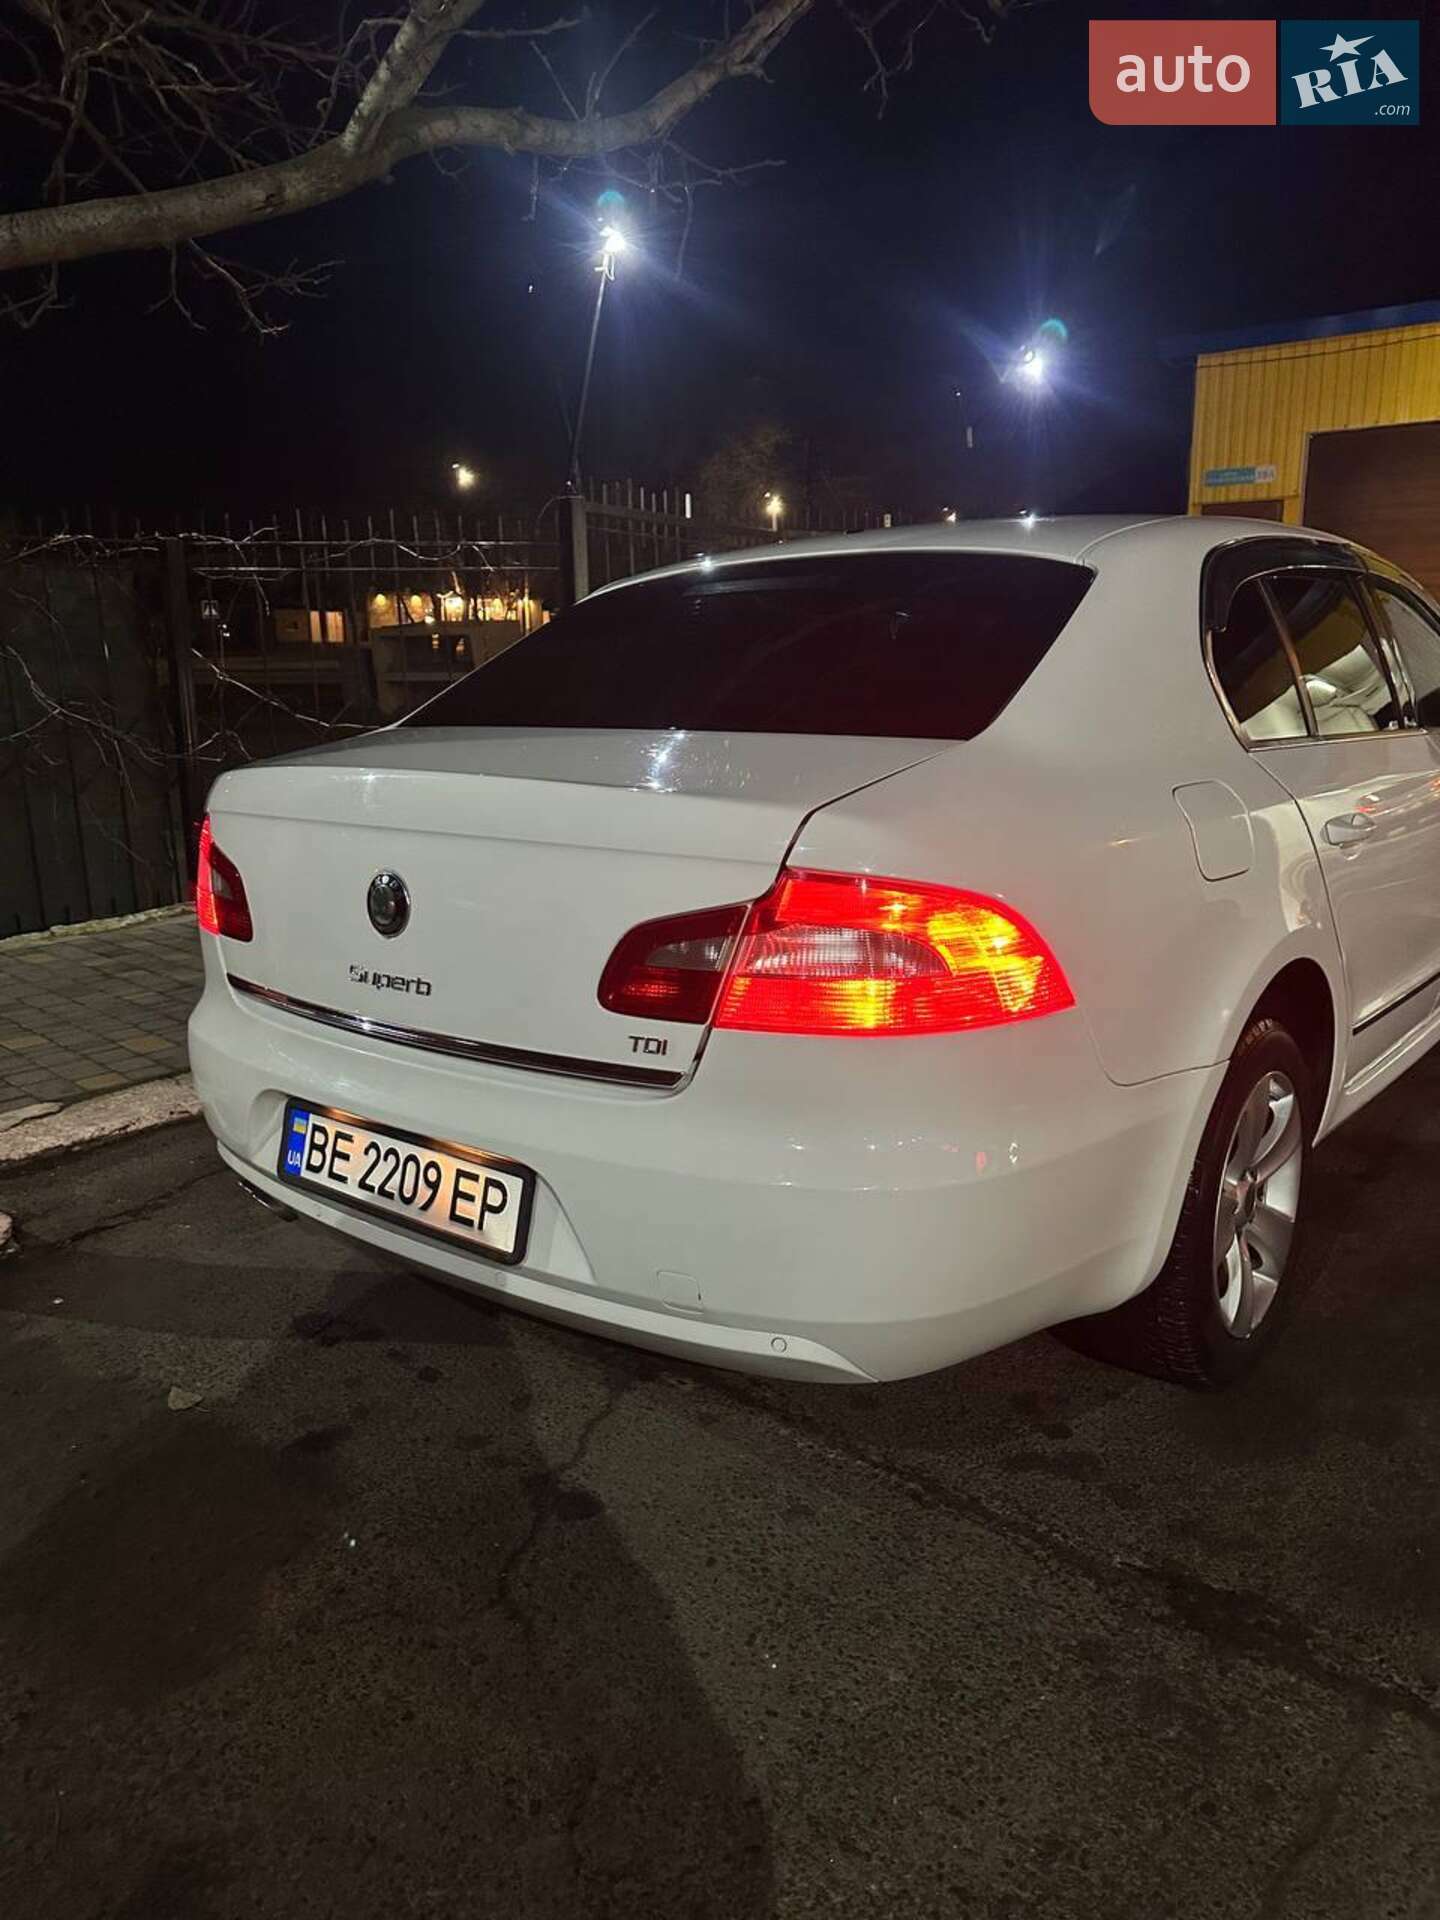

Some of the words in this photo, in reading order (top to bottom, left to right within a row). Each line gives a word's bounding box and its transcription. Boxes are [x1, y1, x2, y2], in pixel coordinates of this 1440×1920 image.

[349, 964, 432, 996] Superb
[628, 1035, 668, 1056] TDI
[287, 1150, 302, 1168] UA
[305, 1123, 354, 1184] BE
[358, 1140, 442, 1211] 2209
[449, 1168, 508, 1231] EP
